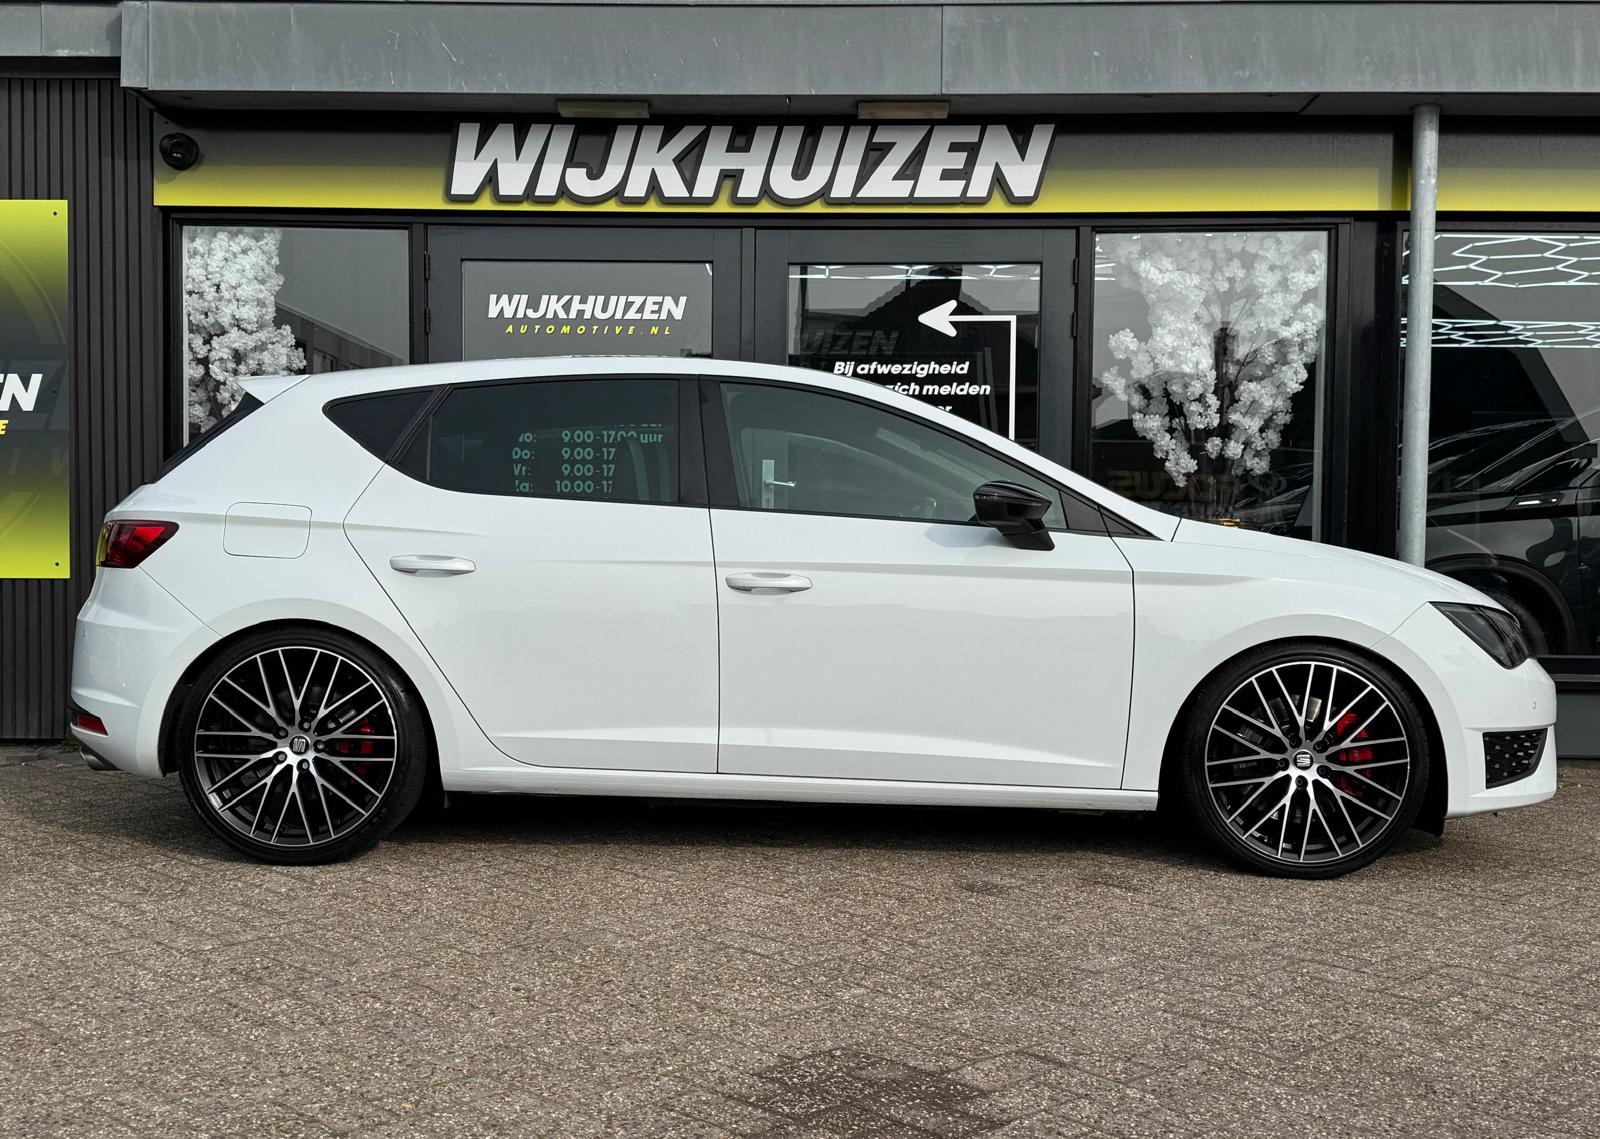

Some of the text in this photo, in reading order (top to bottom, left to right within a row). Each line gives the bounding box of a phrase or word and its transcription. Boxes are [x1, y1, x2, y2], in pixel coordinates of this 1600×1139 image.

[449, 121, 1056, 200] WIJKHUIZEN
[487, 293, 688, 321] WIJKHUIZEN
[504, 324, 672, 336] AUTOMOTIVE.NL
[833, 361, 855, 377] Bij
[857, 361, 969, 378] afwezigheid
[922, 382, 991, 396] melden
[640, 433, 663, 444] uur
